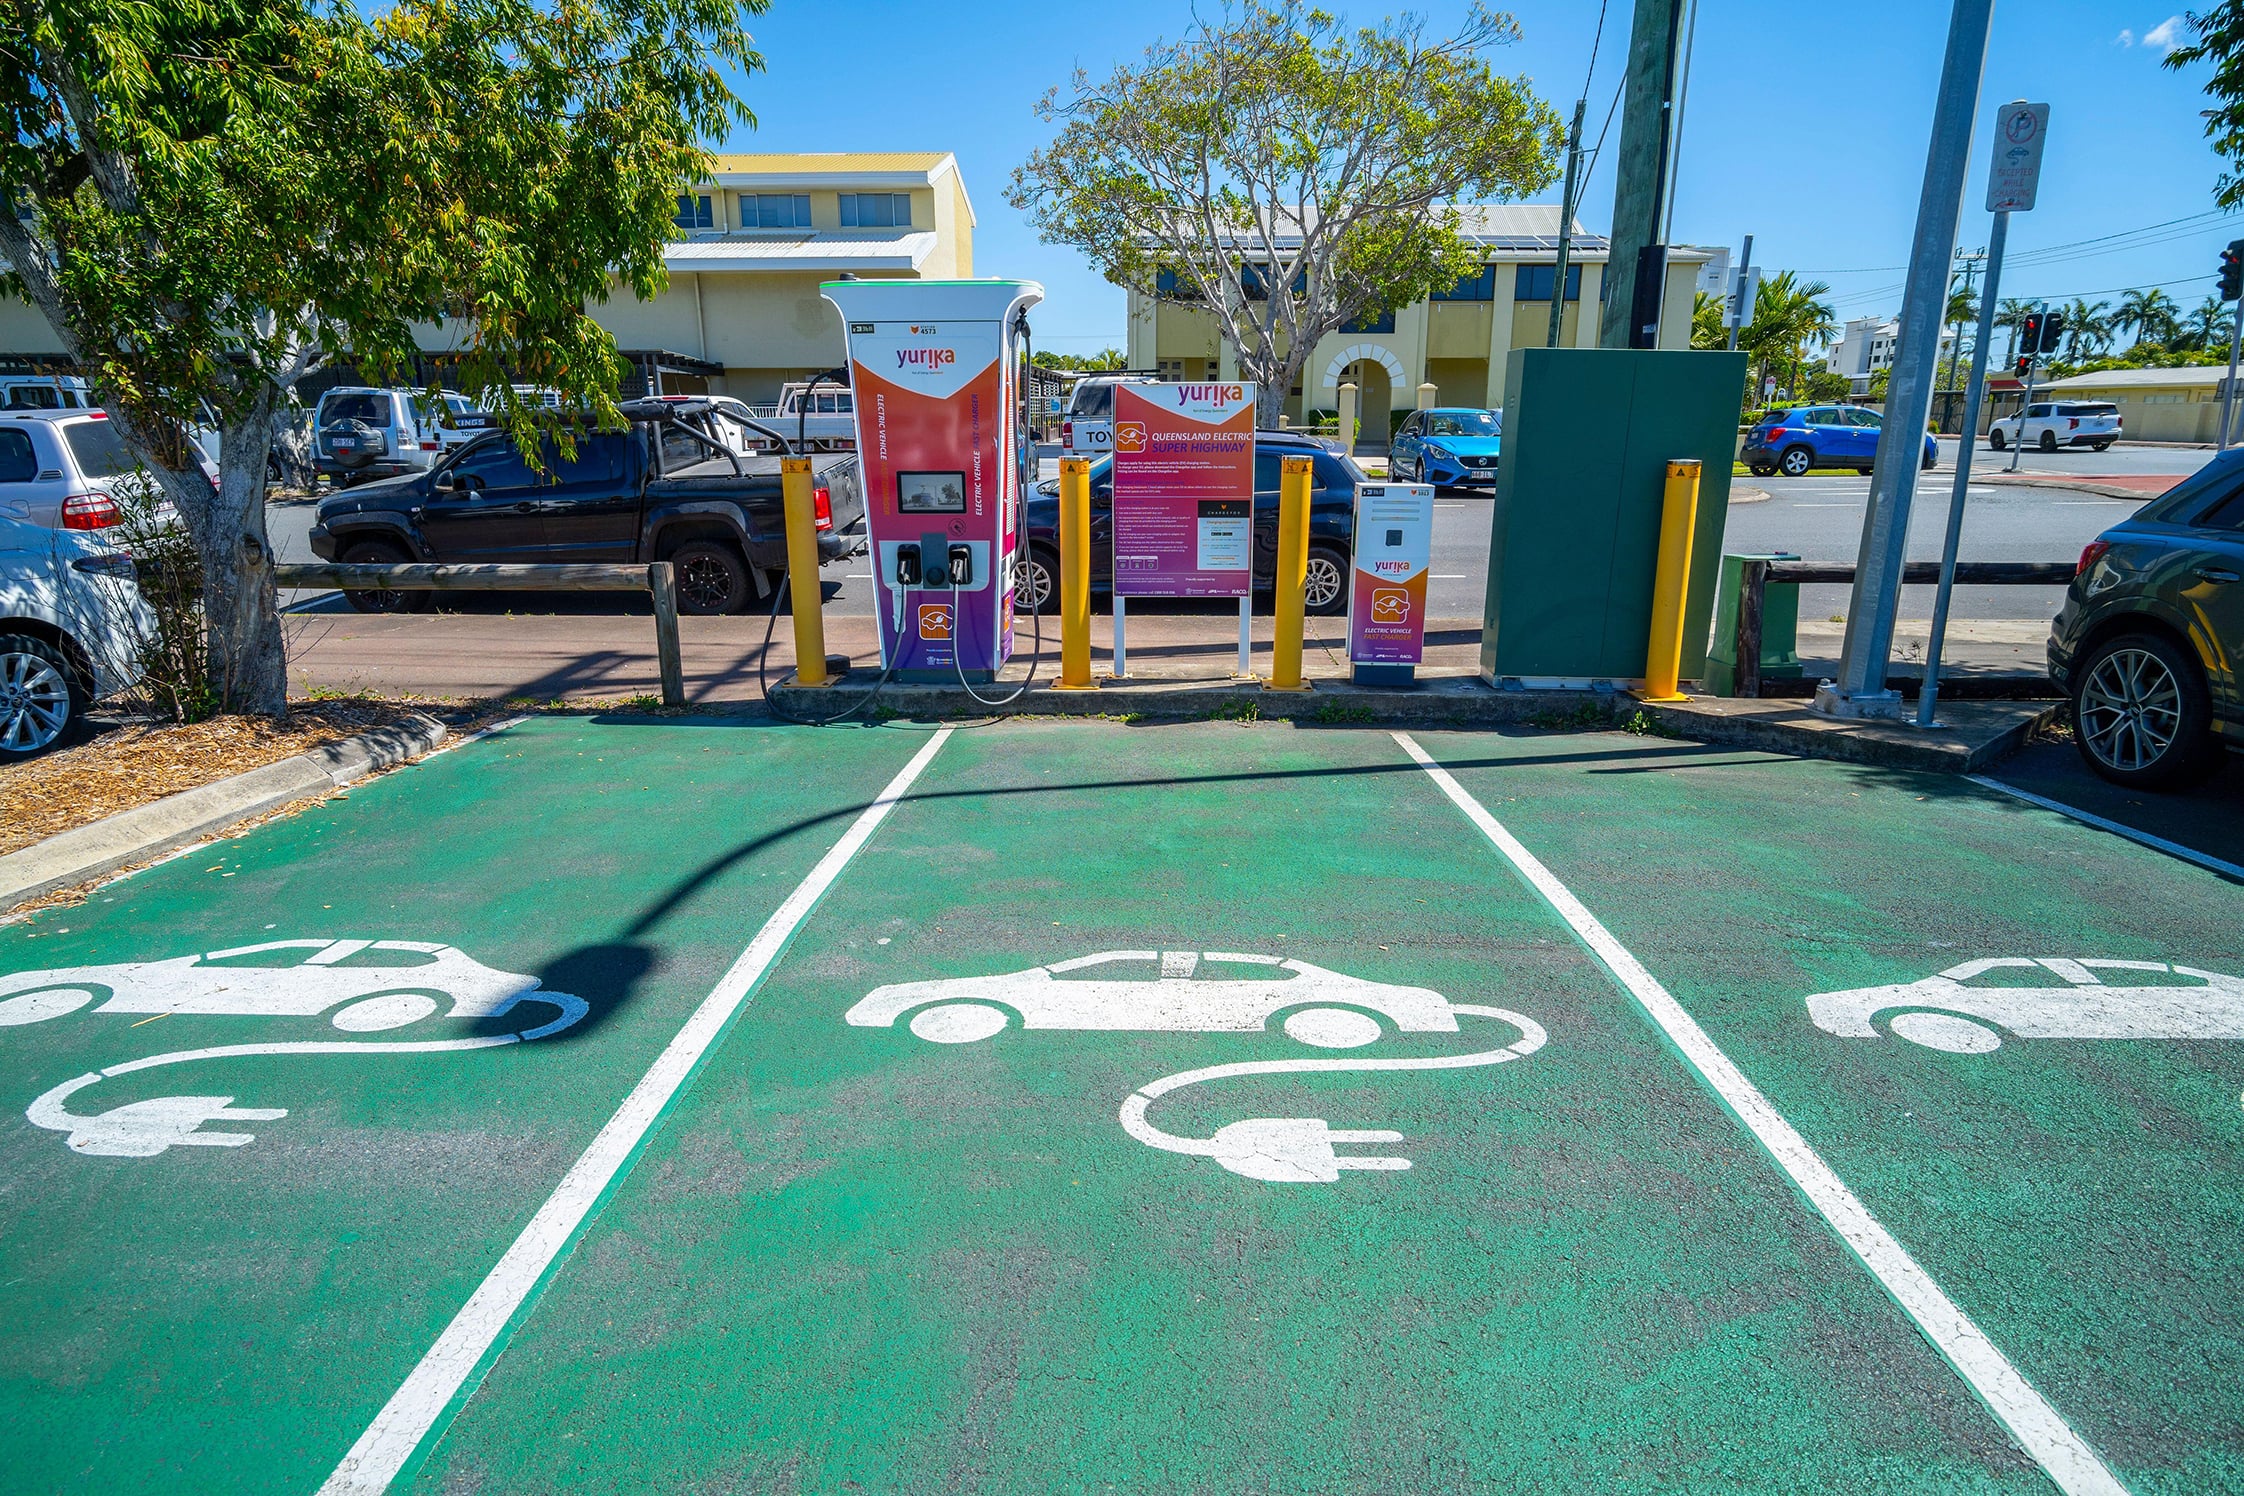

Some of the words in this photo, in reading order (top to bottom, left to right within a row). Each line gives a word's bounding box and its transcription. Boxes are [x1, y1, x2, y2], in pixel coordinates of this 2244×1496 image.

[455, 418, 485, 426] KINGS
[877, 393, 885, 428] ELECTRIC
[971, 393, 979, 430] CHARGER
[878, 429, 888, 461] VEHICLE
[1152, 432, 1211, 442] QUEENSLAND
[1213, 432, 1252, 441] ELECTRIC
[1152, 442, 1188, 453] SUPER
[1190, 442, 1246, 453] HIGHWAY
[973, 450, 981, 482] VEHICLE
[974, 482, 983, 516] ELECTRIC
